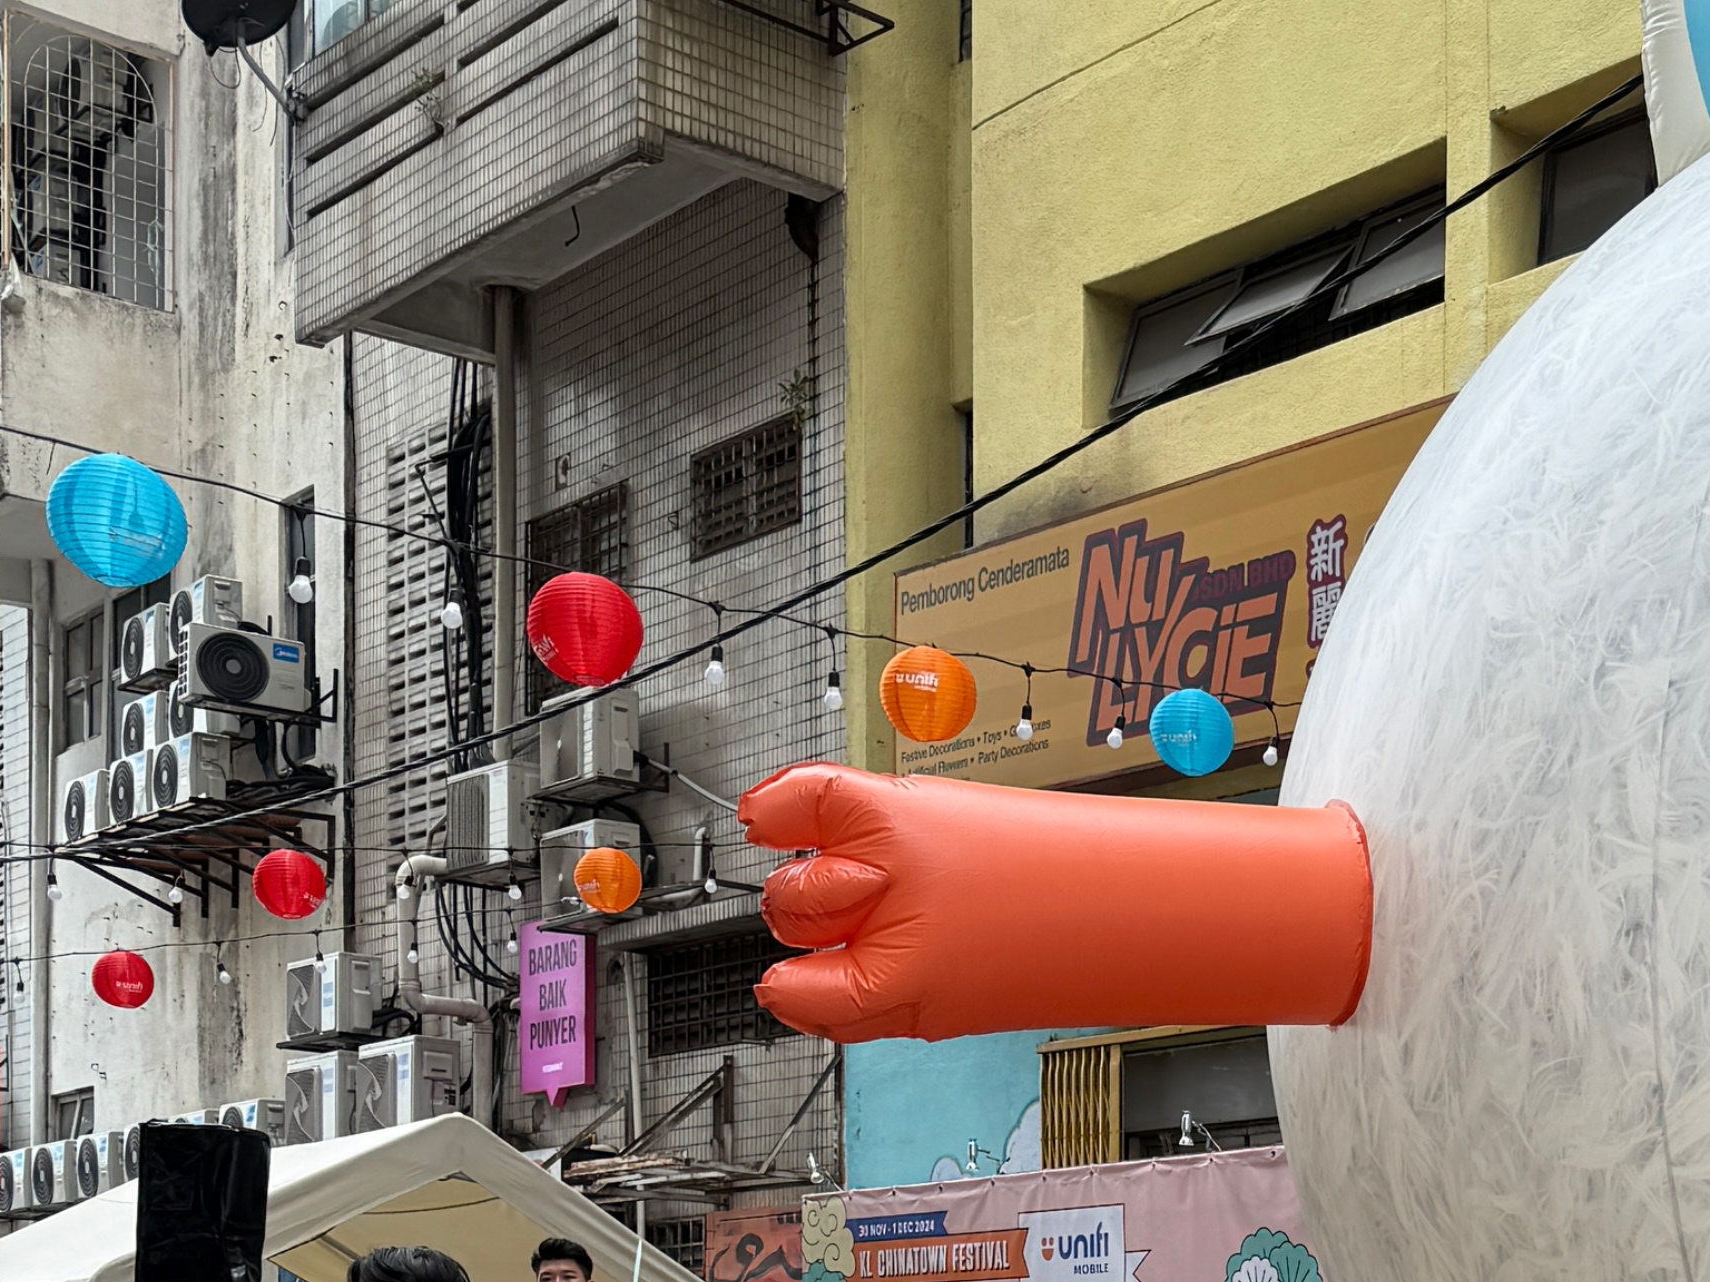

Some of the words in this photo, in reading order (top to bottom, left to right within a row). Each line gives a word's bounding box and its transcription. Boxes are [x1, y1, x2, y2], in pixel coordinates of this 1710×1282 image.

[900, 574, 975, 615] Pemborong
[978, 546, 1070, 593] Cenderamata
[1309, 519, 1345, 645] 新麗
[978, 750, 998, 765] Party
[529, 939, 577, 976] BARANG
[540, 979, 567, 1011] BAIK
[530, 1015, 576, 1050] PUNYER
[914, 1220, 935, 1233] 2024
[1058, 1222, 1109, 1258] unifi
[859, 1254, 873, 1279] KL
[878, 1245, 947, 1277] CHINATOWN
[952, 1240, 1009, 1272] FESTIVAL
[1073, 1263, 1109, 1275] MOBILE
